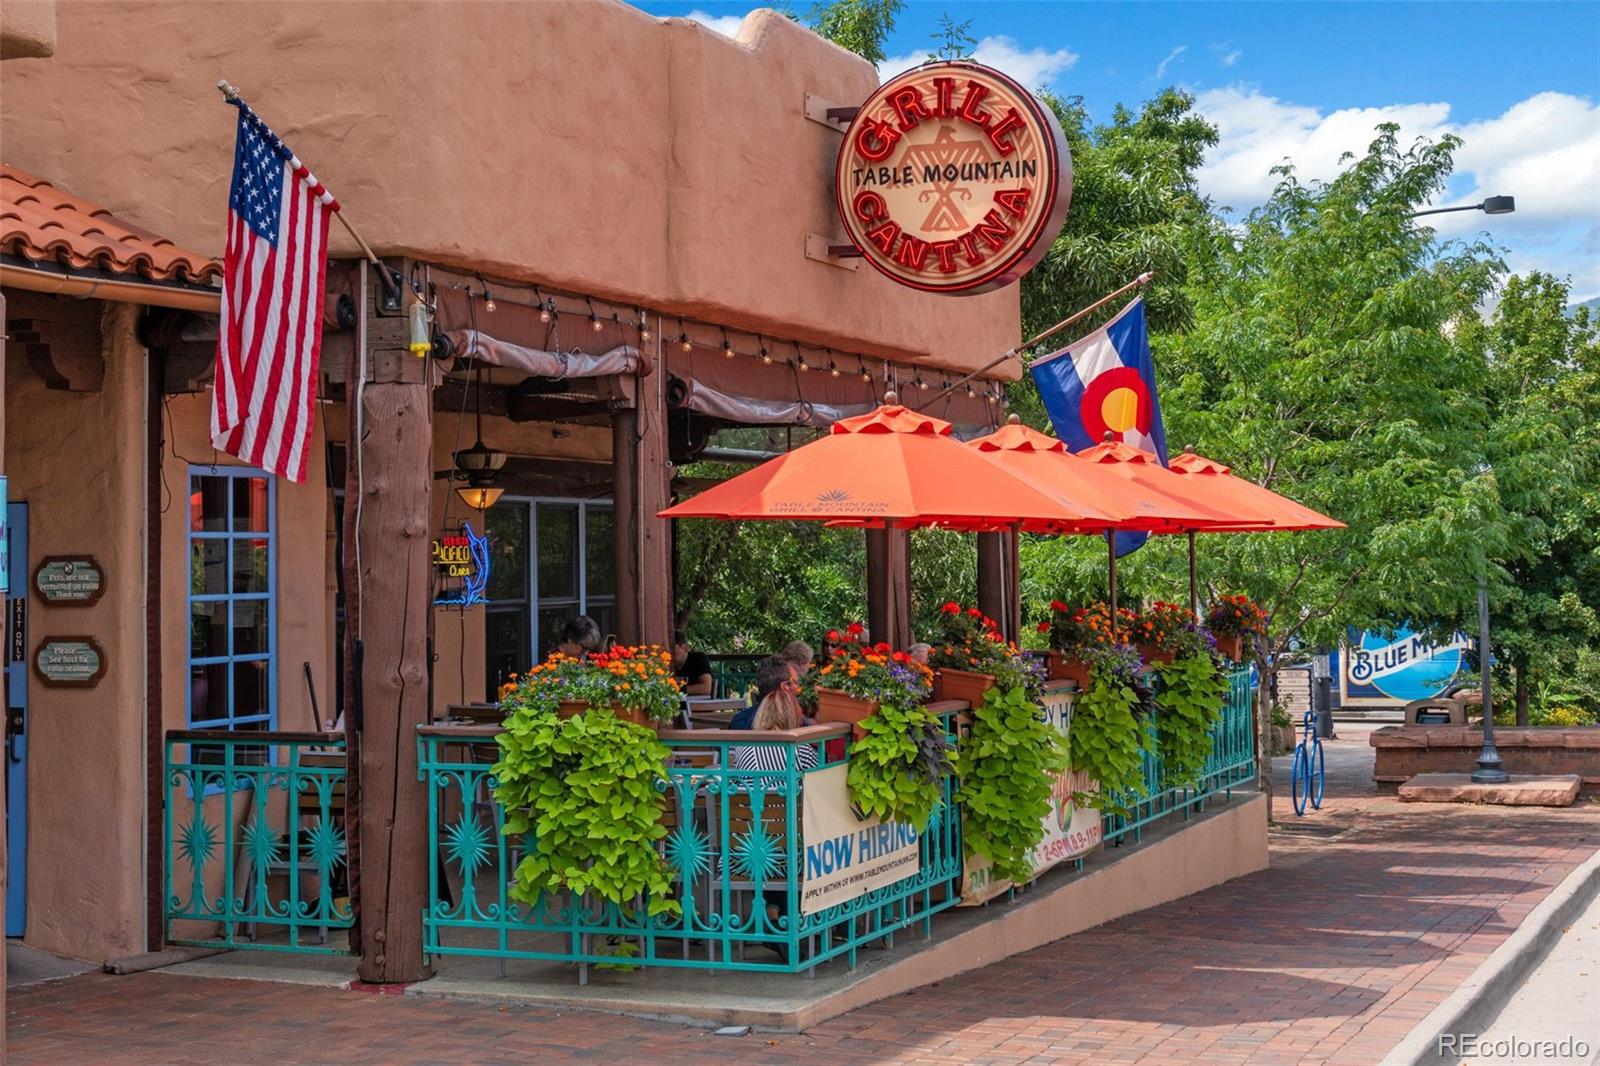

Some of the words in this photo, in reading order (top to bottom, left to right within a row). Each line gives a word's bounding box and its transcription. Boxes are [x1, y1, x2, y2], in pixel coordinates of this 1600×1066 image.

[855, 77, 1026, 162] GRILL
[853, 166, 913, 187] TABLE
[923, 159, 1037, 183] MOUNTAIN
[853, 187, 1030, 273] CANTINA
[15, 631, 23, 662] ONLY
[806, 832, 855, 881] NOW
[858, 820, 917, 864] HIRING
[805, 887, 823, 899] APPLY
[824, 882, 842, 893] WITHIN
[842, 878, 849, 887] OR
